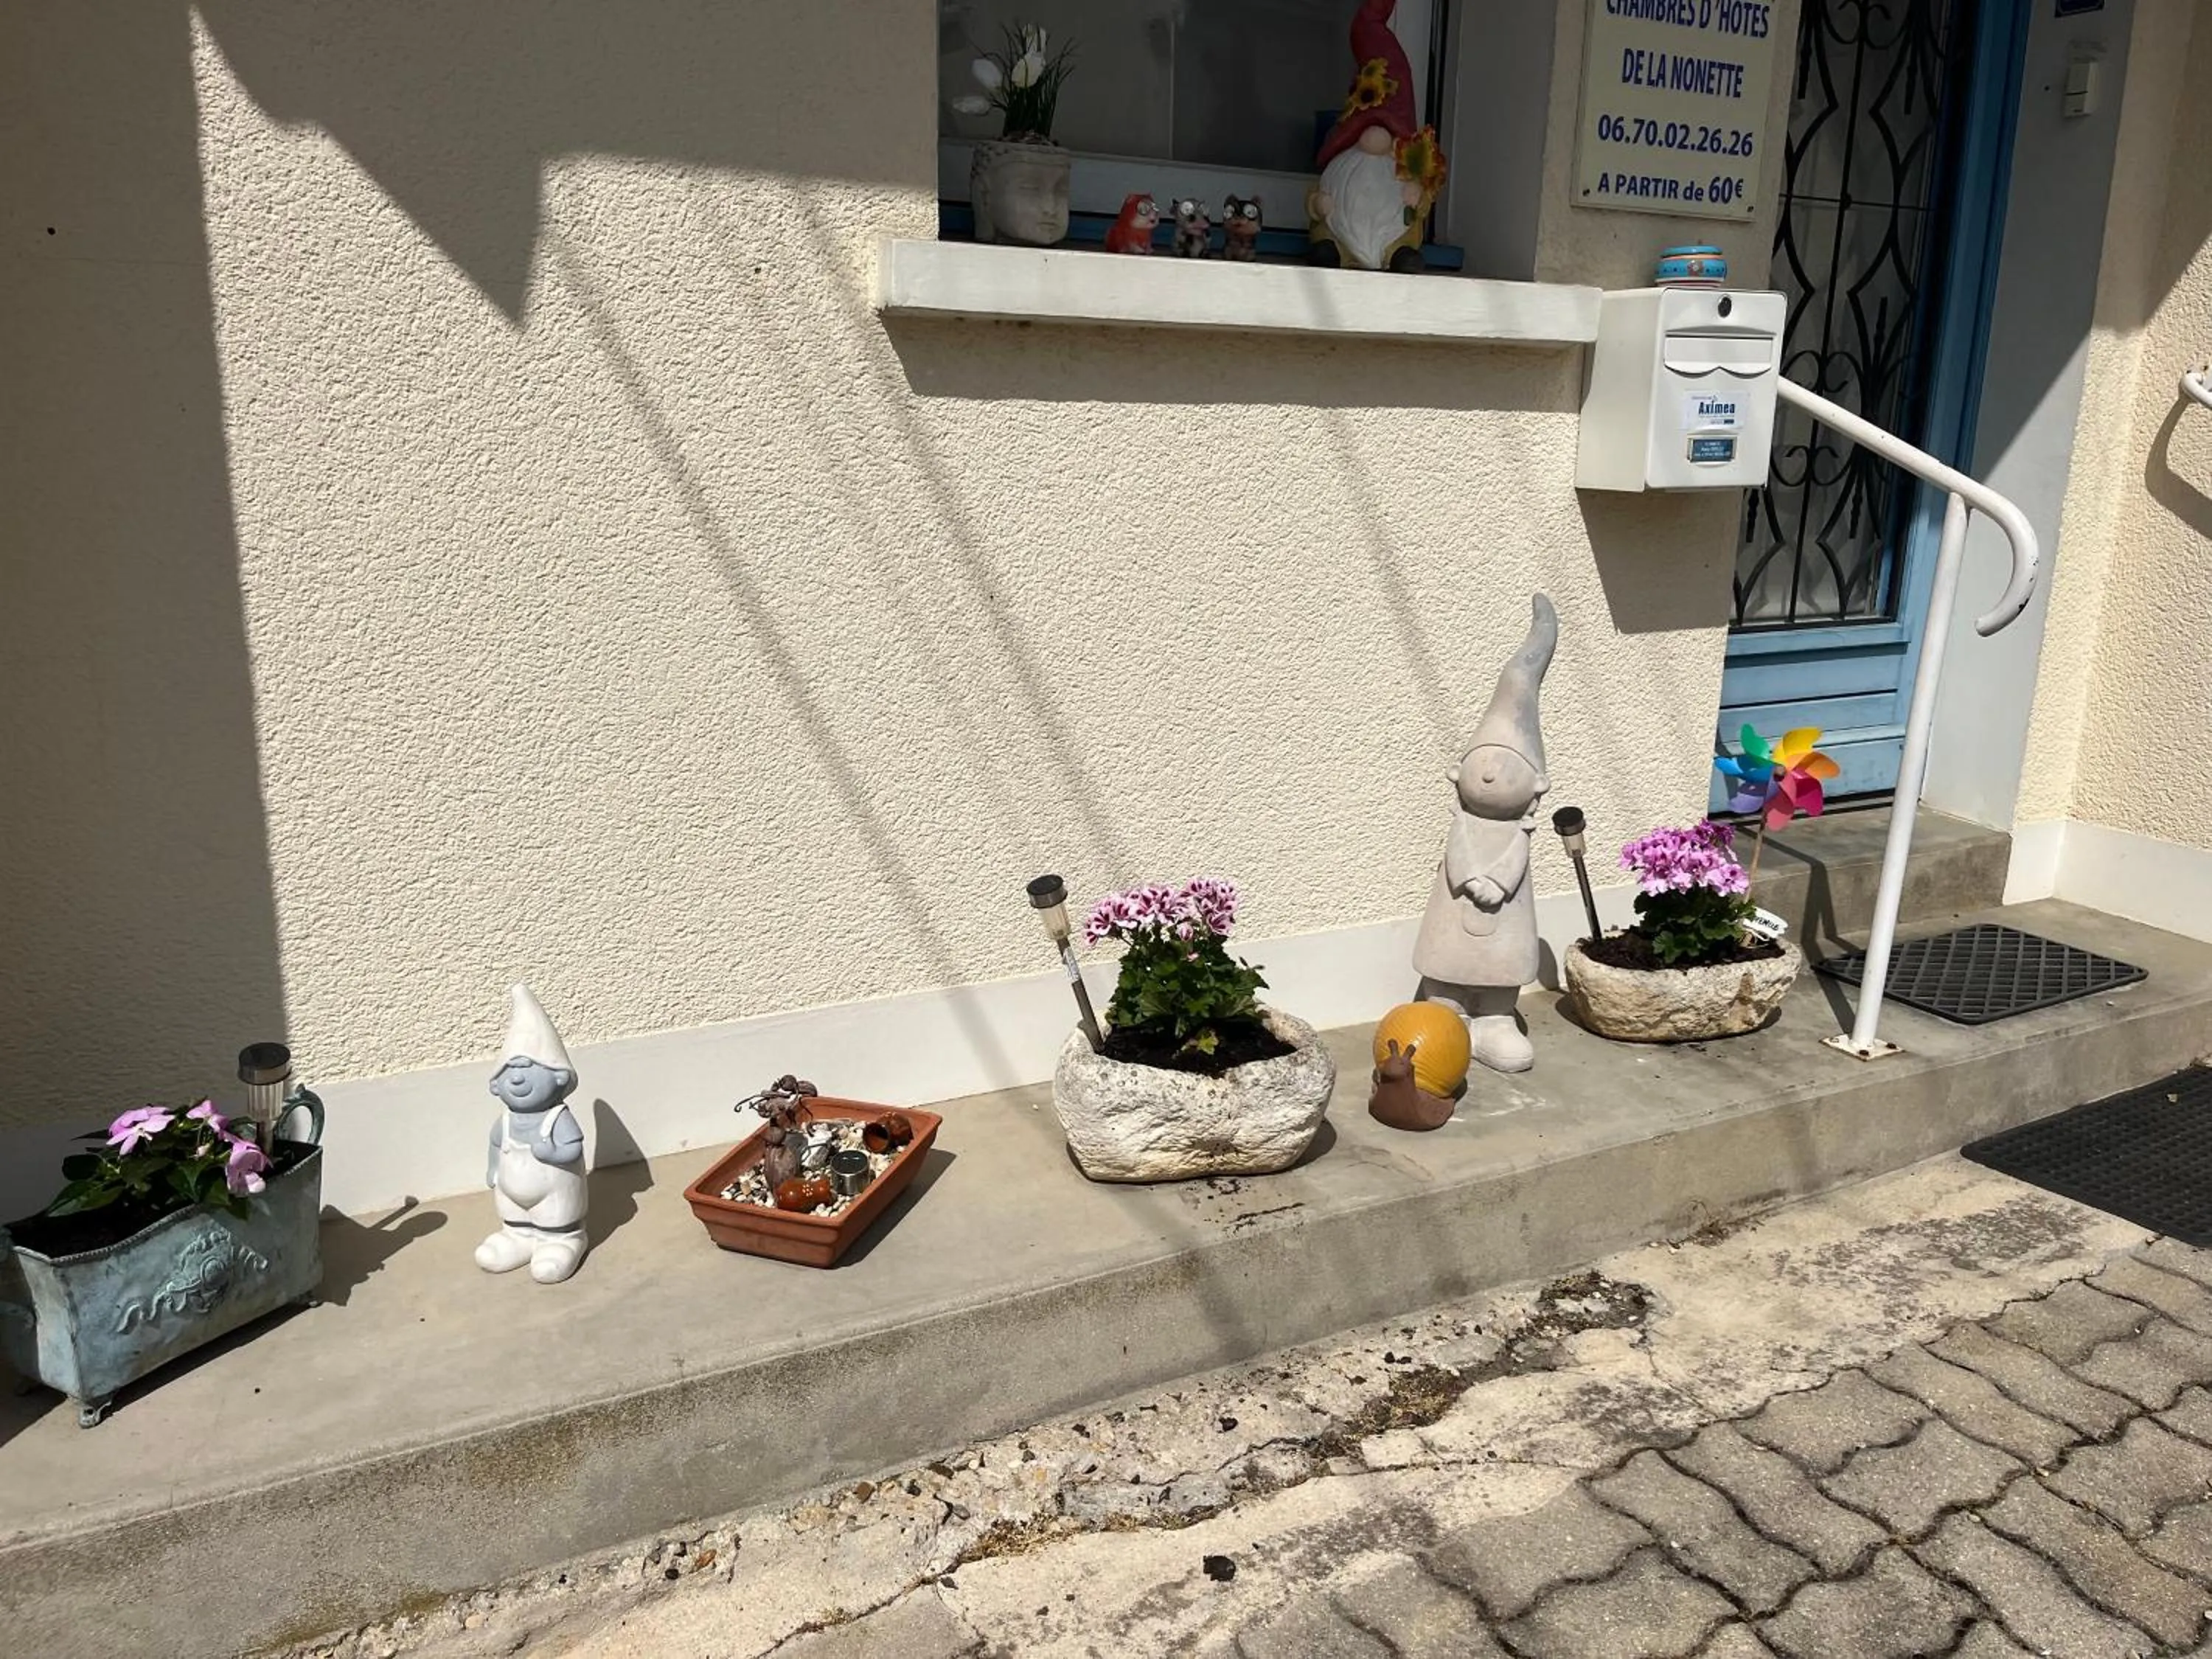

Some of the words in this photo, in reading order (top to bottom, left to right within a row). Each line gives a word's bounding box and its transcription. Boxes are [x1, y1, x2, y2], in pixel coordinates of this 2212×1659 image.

[1622, 48, 1645, 85] DE
[1646, 52, 1666, 88] LA
[1670, 55, 1744, 97] NONETTE
[1598, 114, 1753, 157] 06.70.02.26.26
[1598, 173, 1610, 192] A
[1615, 174, 1679, 199] PARTIR
[1683, 181, 1704, 201] de
[1708, 176, 1744, 204] 60€
[1698, 401, 1735, 414] Aximea
